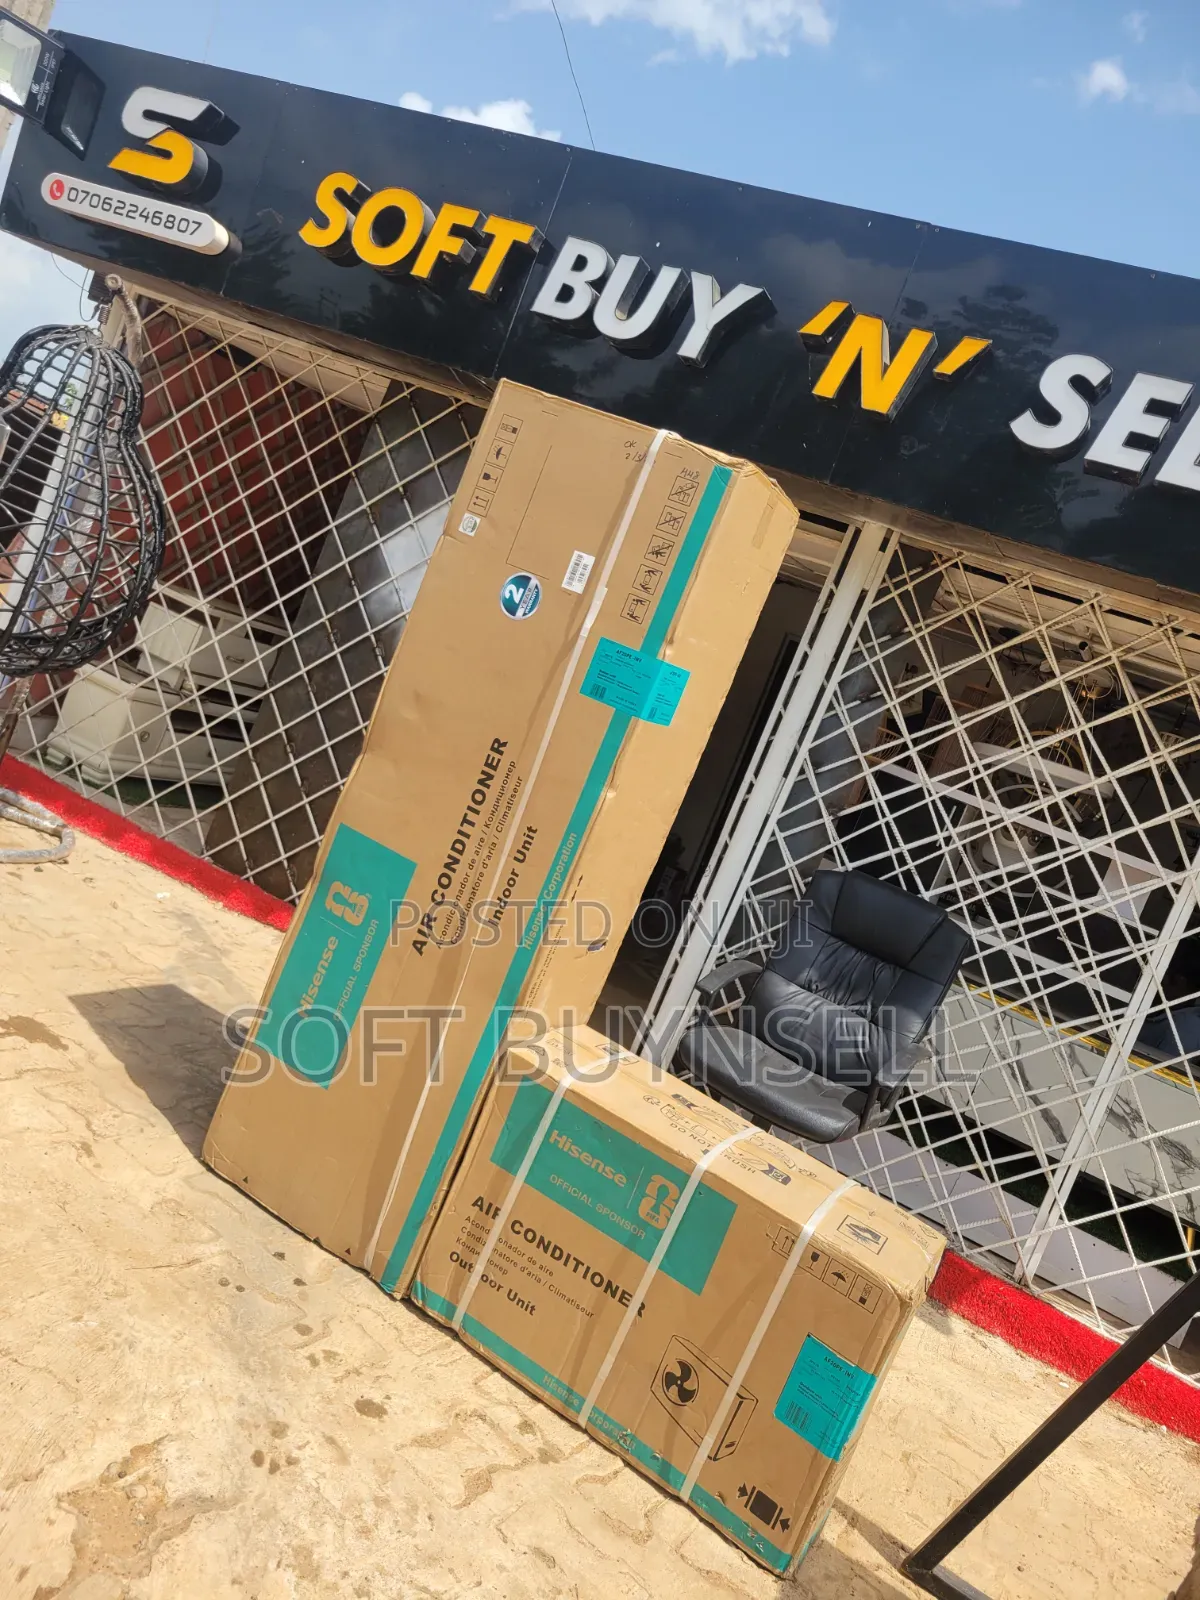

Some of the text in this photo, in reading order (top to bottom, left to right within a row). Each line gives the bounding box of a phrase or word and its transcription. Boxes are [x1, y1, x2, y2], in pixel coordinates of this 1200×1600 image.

[67, 187, 202, 235] 07062246807
[299, 171, 538, 294] SOFT
[530, 235, 766, 361] BUY
[505, 584, 524, 604] 2
[520, 587, 532, 609] YEAR
[525, 588, 538, 614] WARRANTY
[411, 737, 508, 956] AIR CONDITIONER
[468, 857, 476, 870] de
[473, 837, 485, 856] aire
[484, 760, 516, 829] Кондиционер
[482, 841, 497, 870] d'aria
[496, 775, 523, 834] Climatiseur
[488, 825, 538, 927] Indoor Unit
[523, 832, 577, 950] Hisense Corporation
[297, 936, 339, 1020] Hisense
[334, 919, 379, 1022] OFFICIAL SPONSOR
[548, 1130, 628, 1188] Hisense
[670, 1122, 756, 1175] DO NOT RUSH
[549, 1173, 646, 1240] OFFICIAL SPONSOR
[449, 1251, 536, 1316] Outoor Unit
[520, 1266, 542, 1285] d'aria
[548, 1284, 595, 1319] Climatiseur
[527, 1255, 537, 1266] de
[538, 1264, 554, 1277] aire
[543, 1375, 580, 1406] Hisense
